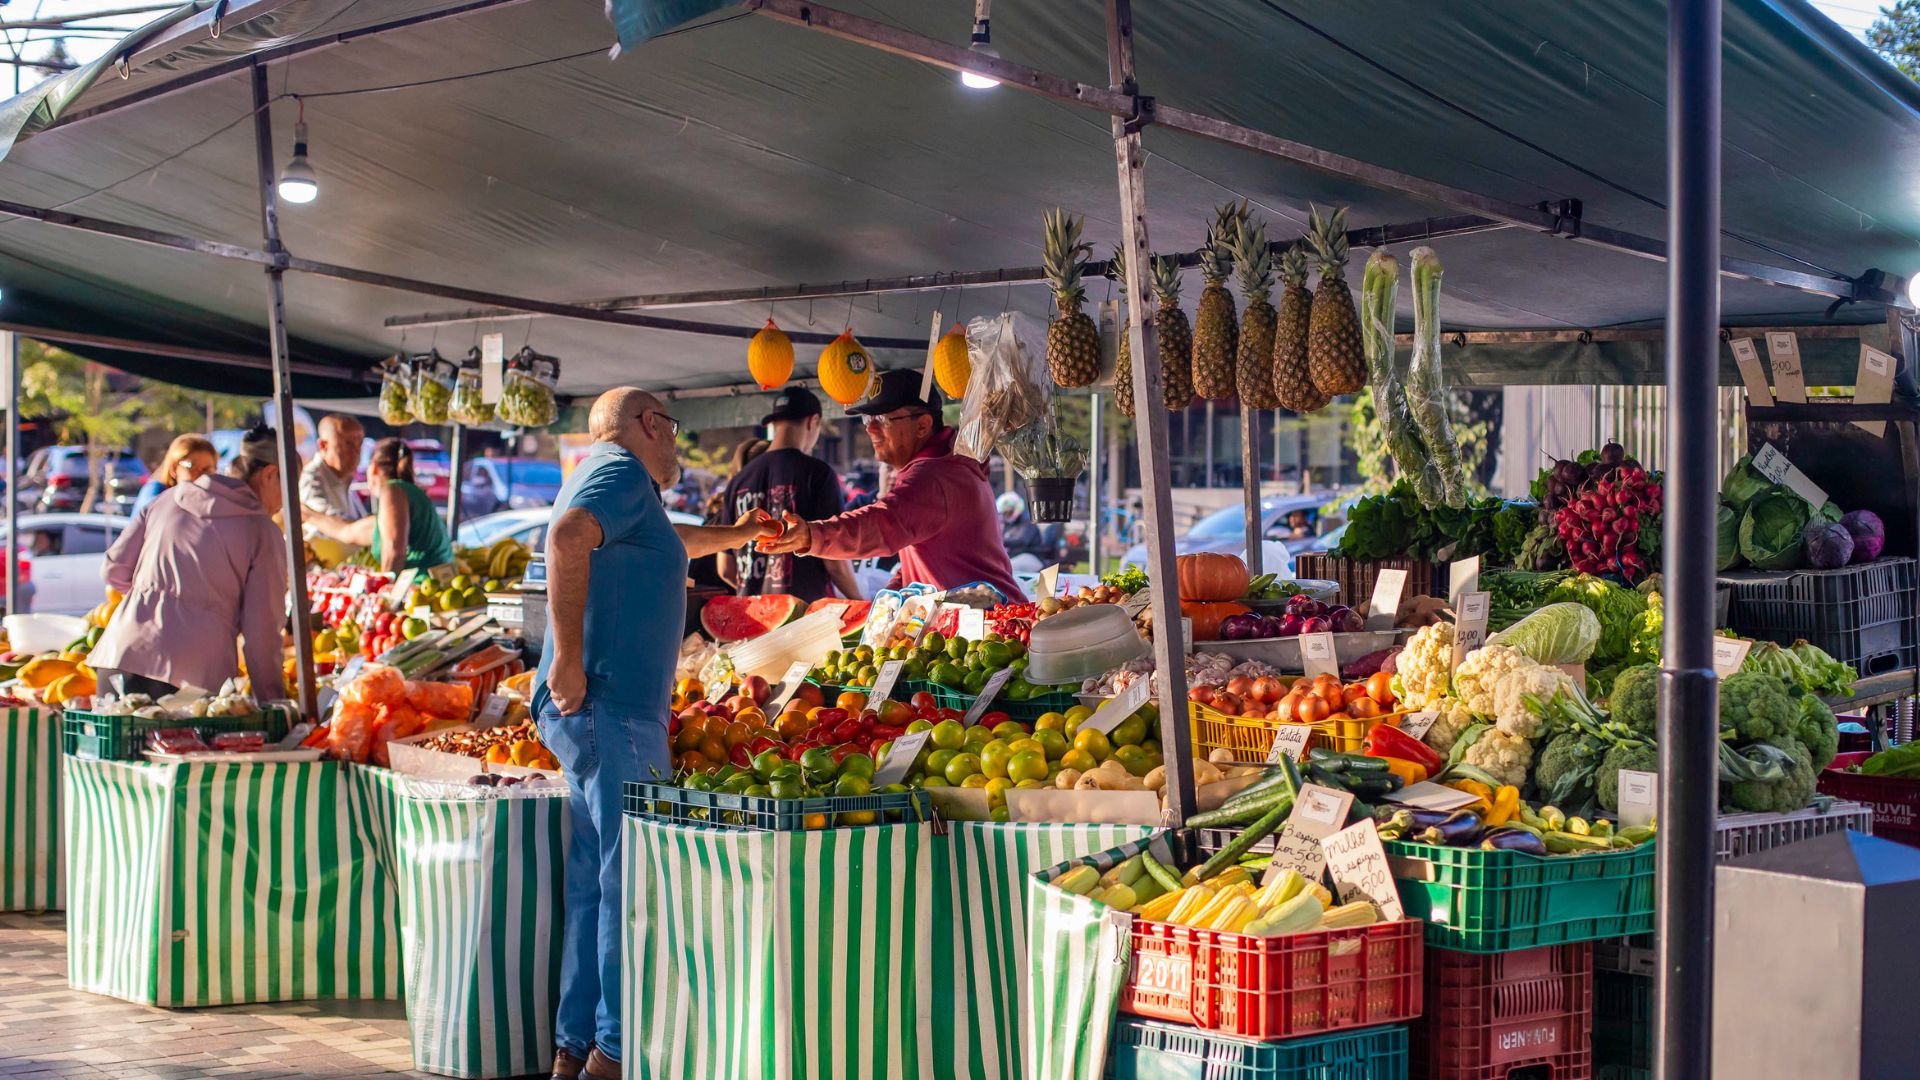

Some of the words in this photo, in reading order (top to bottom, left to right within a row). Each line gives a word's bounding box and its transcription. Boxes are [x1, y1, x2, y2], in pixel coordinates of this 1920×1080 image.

[1772, 360, 1792, 375] 5,00
[1277, 727, 1302, 744] Batata
[1863, 801, 1918, 818] RUVIL
[1872, 814, 1911, 825] 343-1025
[1282, 824, 1295, 838] 3
[1294, 832, 1321, 850] espig
[1294, 849, 1323, 866] 5,00
[1332, 865, 1343, 883] 3
[1345, 852, 1381, 874] espigas
[1341, 884, 1362, 904] por
[1361, 870, 1386, 894] 5,00
[1140, 958, 1188, 994] 2011
